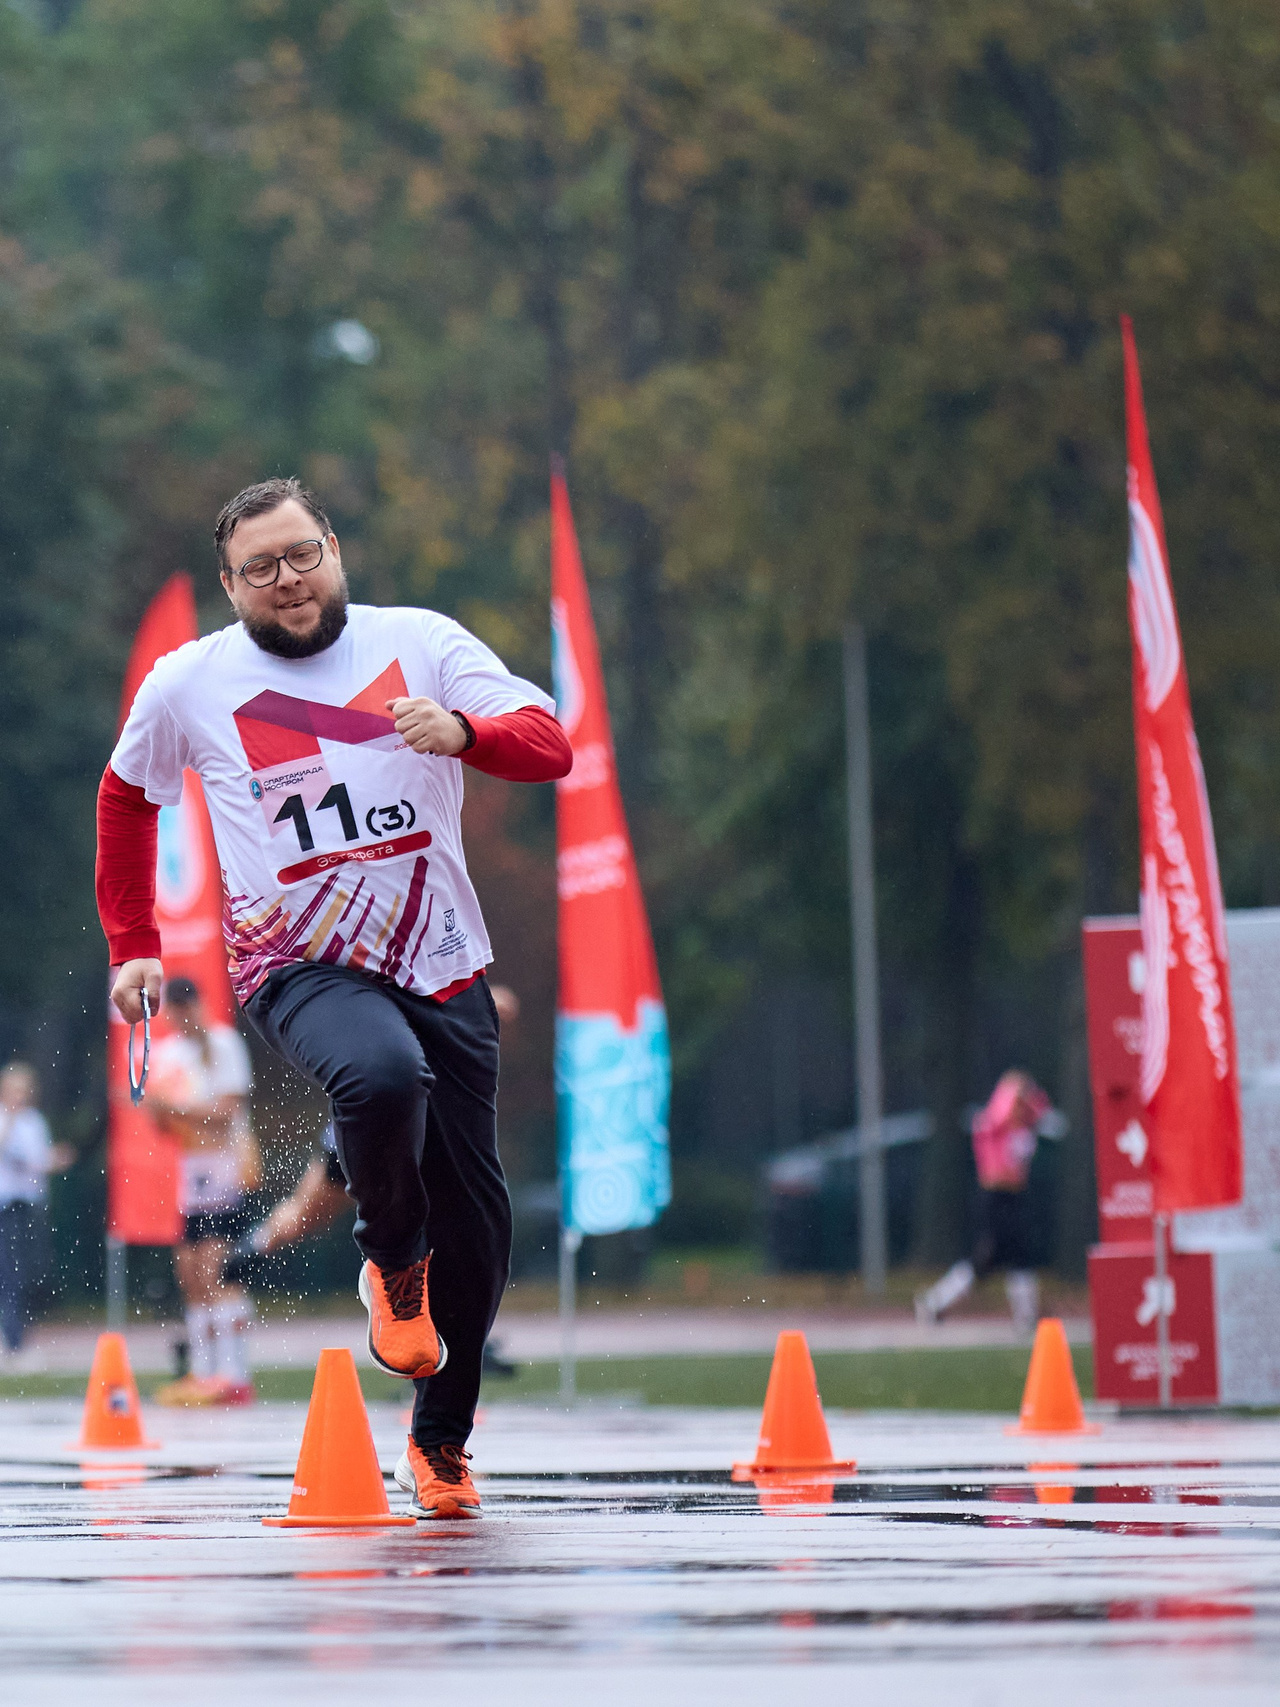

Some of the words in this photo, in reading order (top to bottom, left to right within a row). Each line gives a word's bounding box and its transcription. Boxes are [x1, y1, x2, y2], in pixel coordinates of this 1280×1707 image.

[263, 766, 324, 787] СПАРТАКИАДА
[264, 777, 304, 792] МОСПРОМ
[273, 782, 359, 852] 11
[365, 799, 416, 837] (3)
[317, 845, 395, 867] Эстафета
